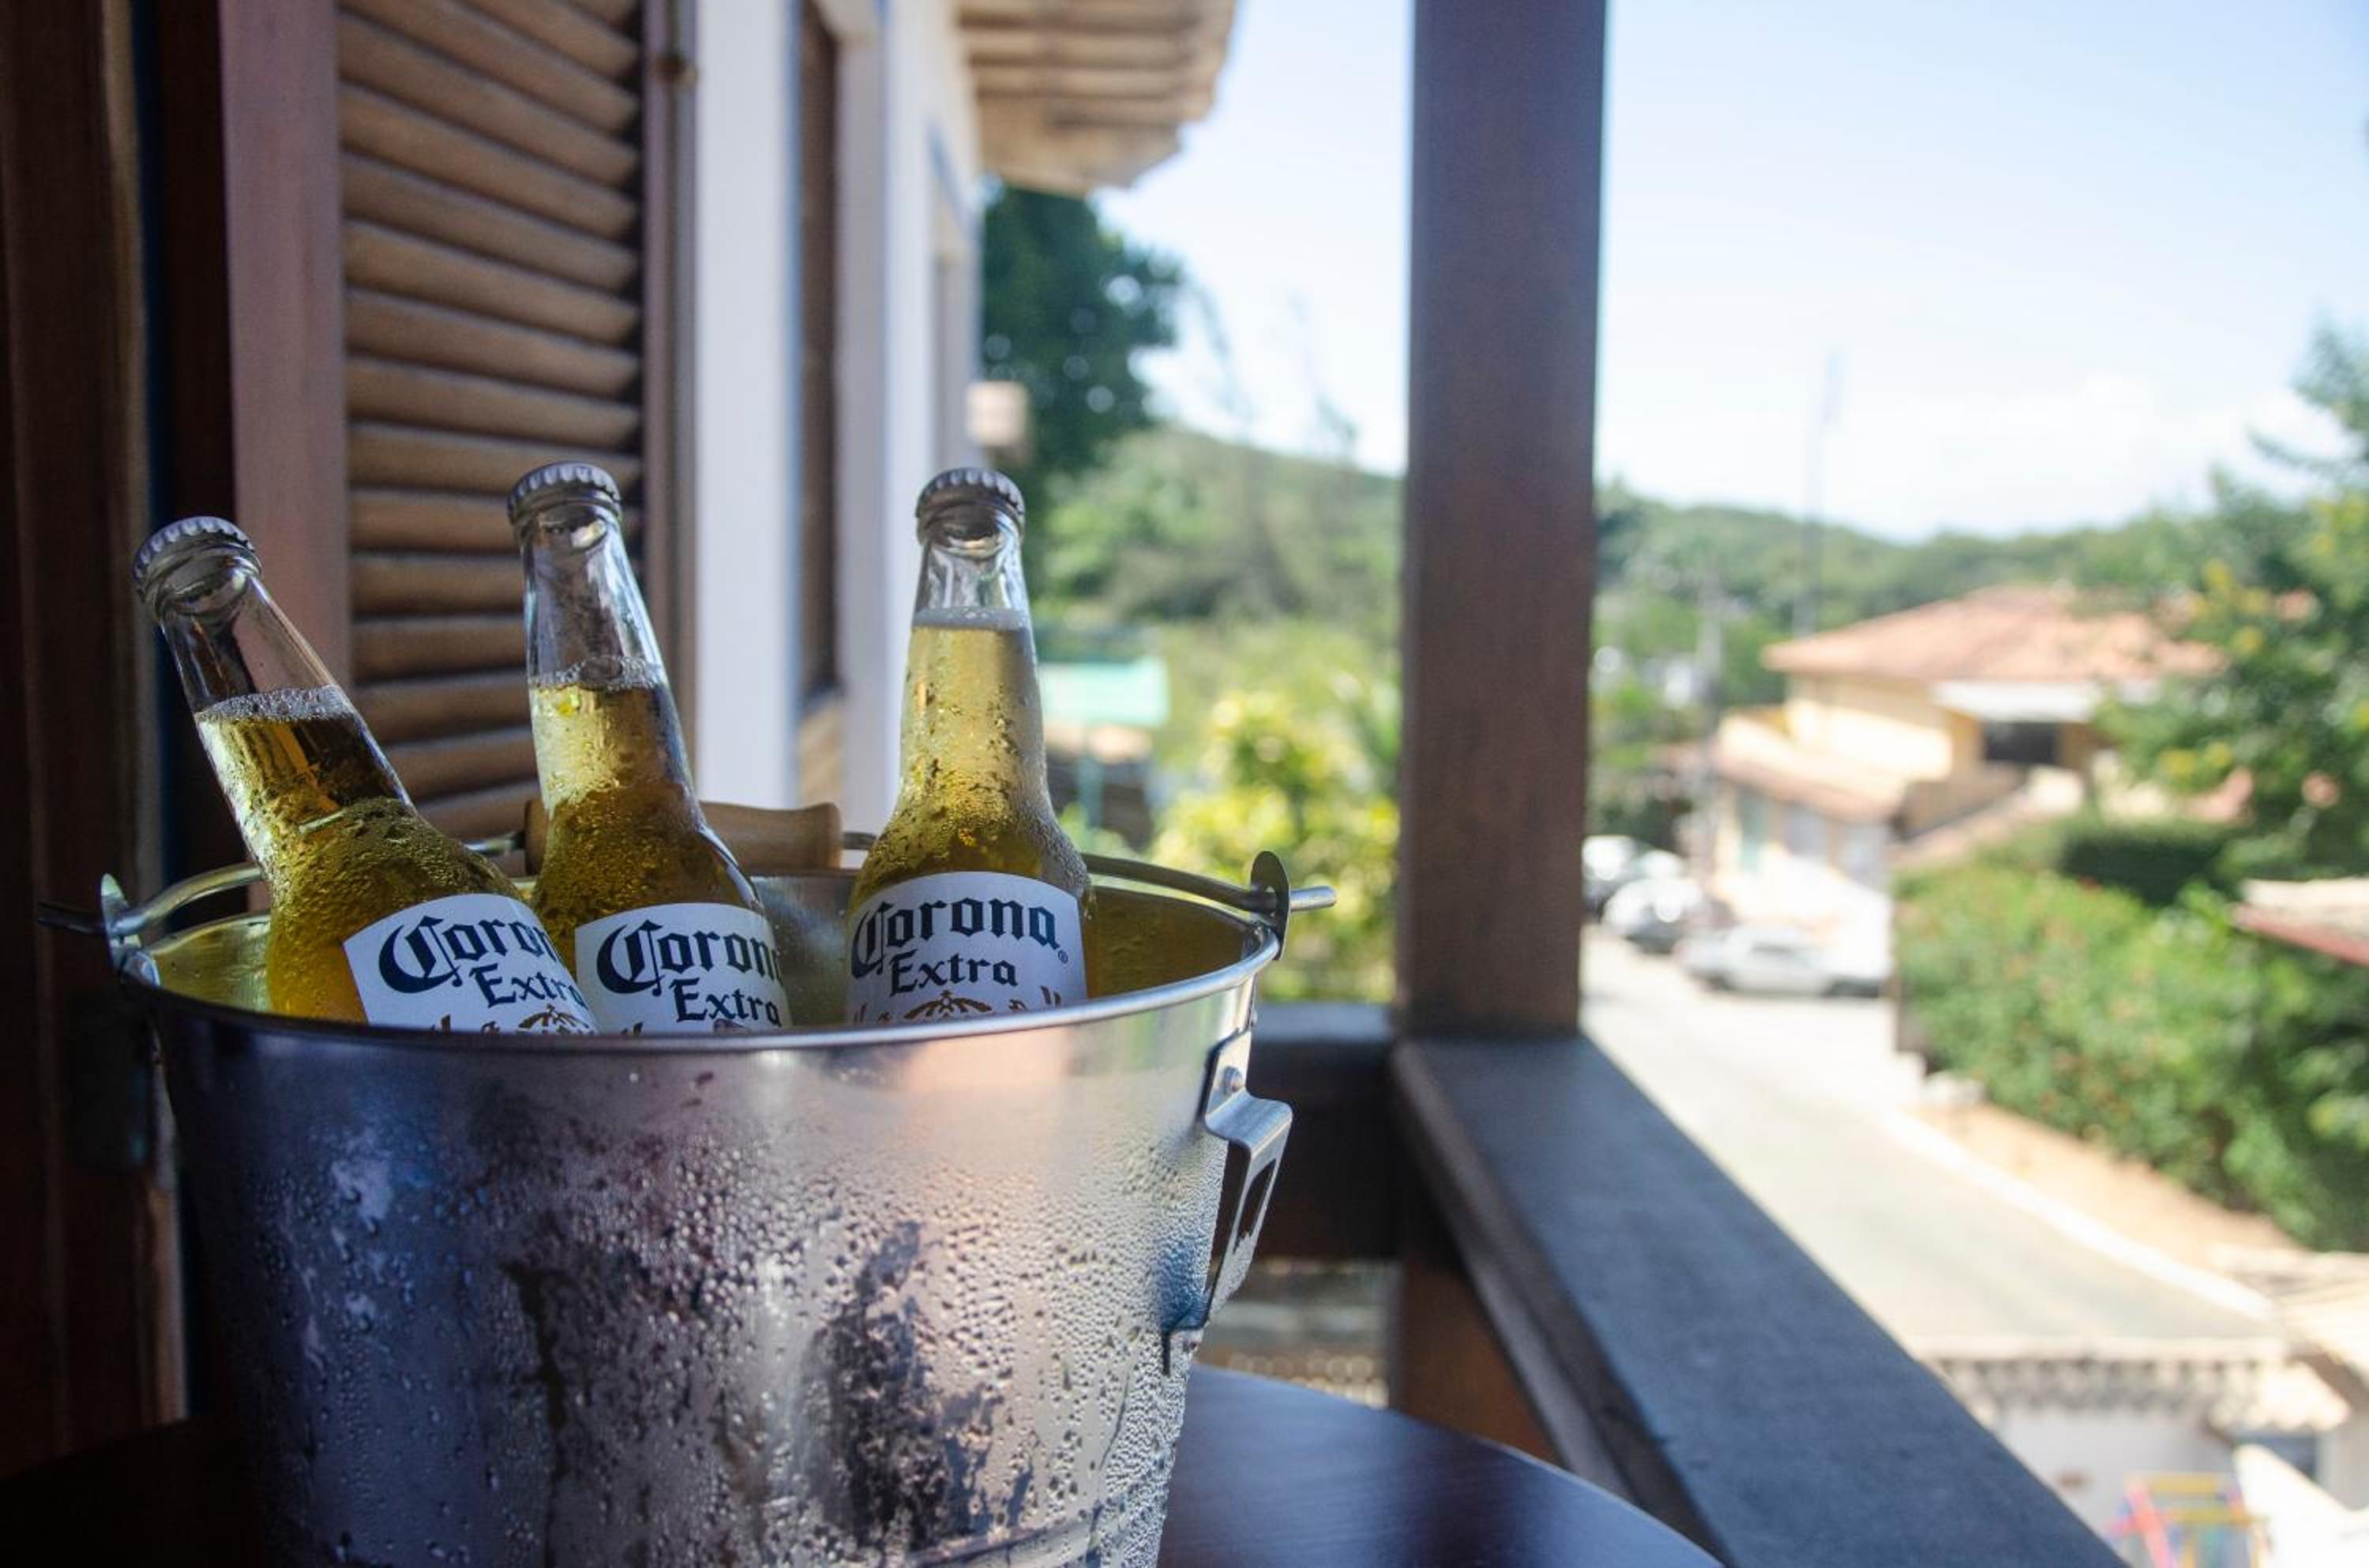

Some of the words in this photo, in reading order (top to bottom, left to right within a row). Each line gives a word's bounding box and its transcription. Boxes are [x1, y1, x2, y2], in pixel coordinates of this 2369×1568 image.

[850, 897, 1060, 979] Corona
[889, 948, 1019, 998] Extra
[669, 977, 783, 1027] Extra
